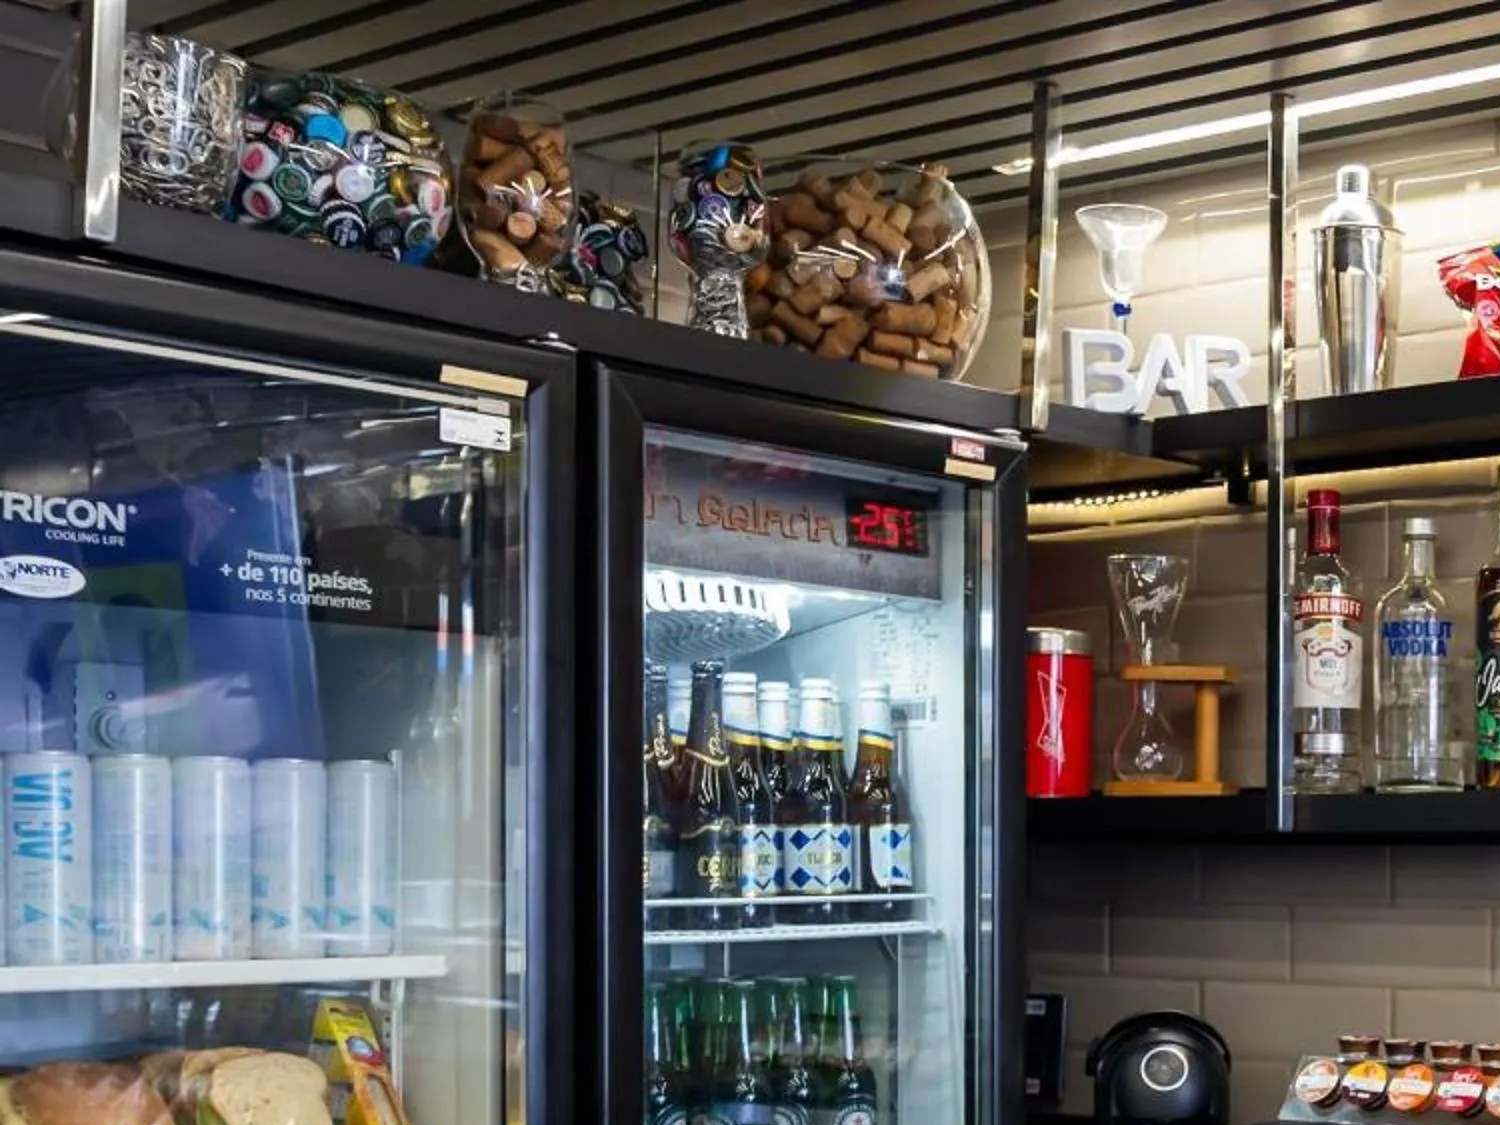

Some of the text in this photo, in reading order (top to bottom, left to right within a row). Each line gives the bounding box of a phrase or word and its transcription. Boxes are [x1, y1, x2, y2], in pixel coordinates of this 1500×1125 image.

[1062, 327, 1250, 418] BAR
[45, 529, 126, 547] COOLING LIFE
[18, 563, 71, 578] NORTE
[237, 562, 264, 582] de
[270, 566, 302, 585] 110
[308, 569, 373, 594] países,
[245, 588, 371, 611] nos 5 continentes
[1382, 620, 1454, 639] ABSOLUT
[1388, 639, 1447, 656] VODKA
